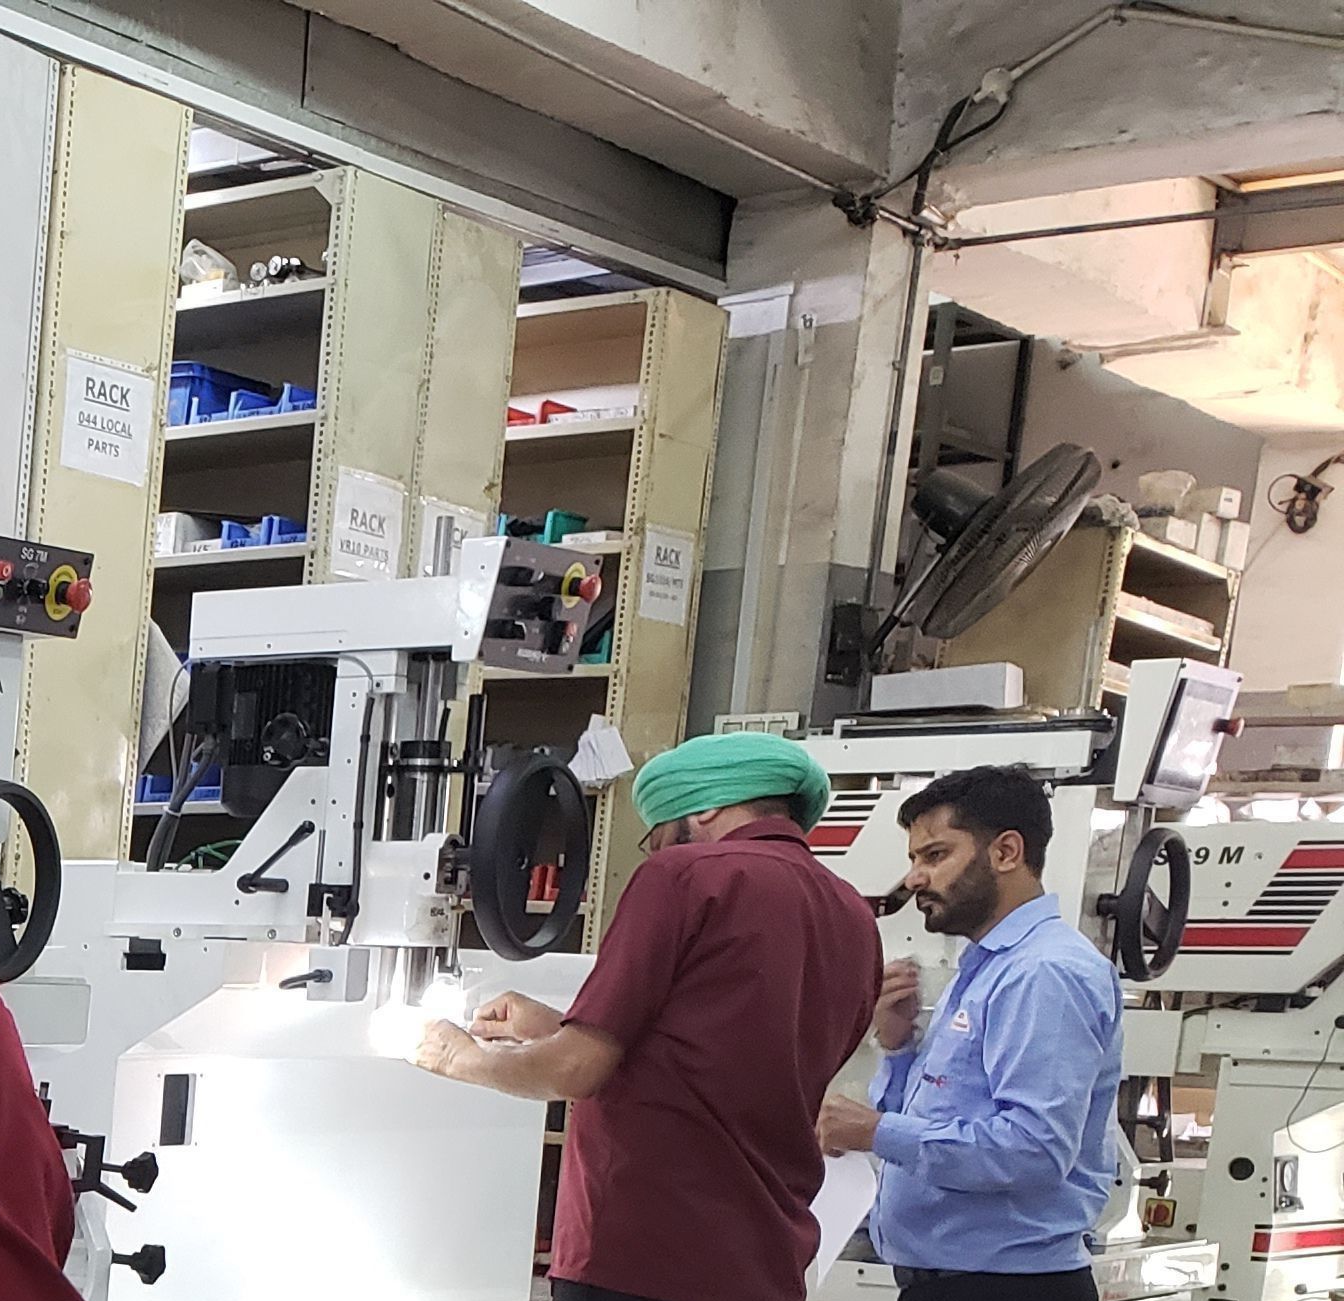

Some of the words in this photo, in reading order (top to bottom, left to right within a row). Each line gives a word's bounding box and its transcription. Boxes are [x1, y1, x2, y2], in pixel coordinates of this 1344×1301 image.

[85, 376, 131, 408] RACK
[78, 411, 97, 427] 044
[100, 416, 133, 437] LOCAL
[87, 438, 120, 457] PARTS
[350, 507, 386, 535] RACK
[20, 547, 34, 560] SG
[35, 549, 49, 562] 7M
[363, 544, 389, 561] PARTS
[655, 545, 682, 565] RACK
[1153, 846, 1210, 866] S9
[1218, 846, 1245, 865] M
